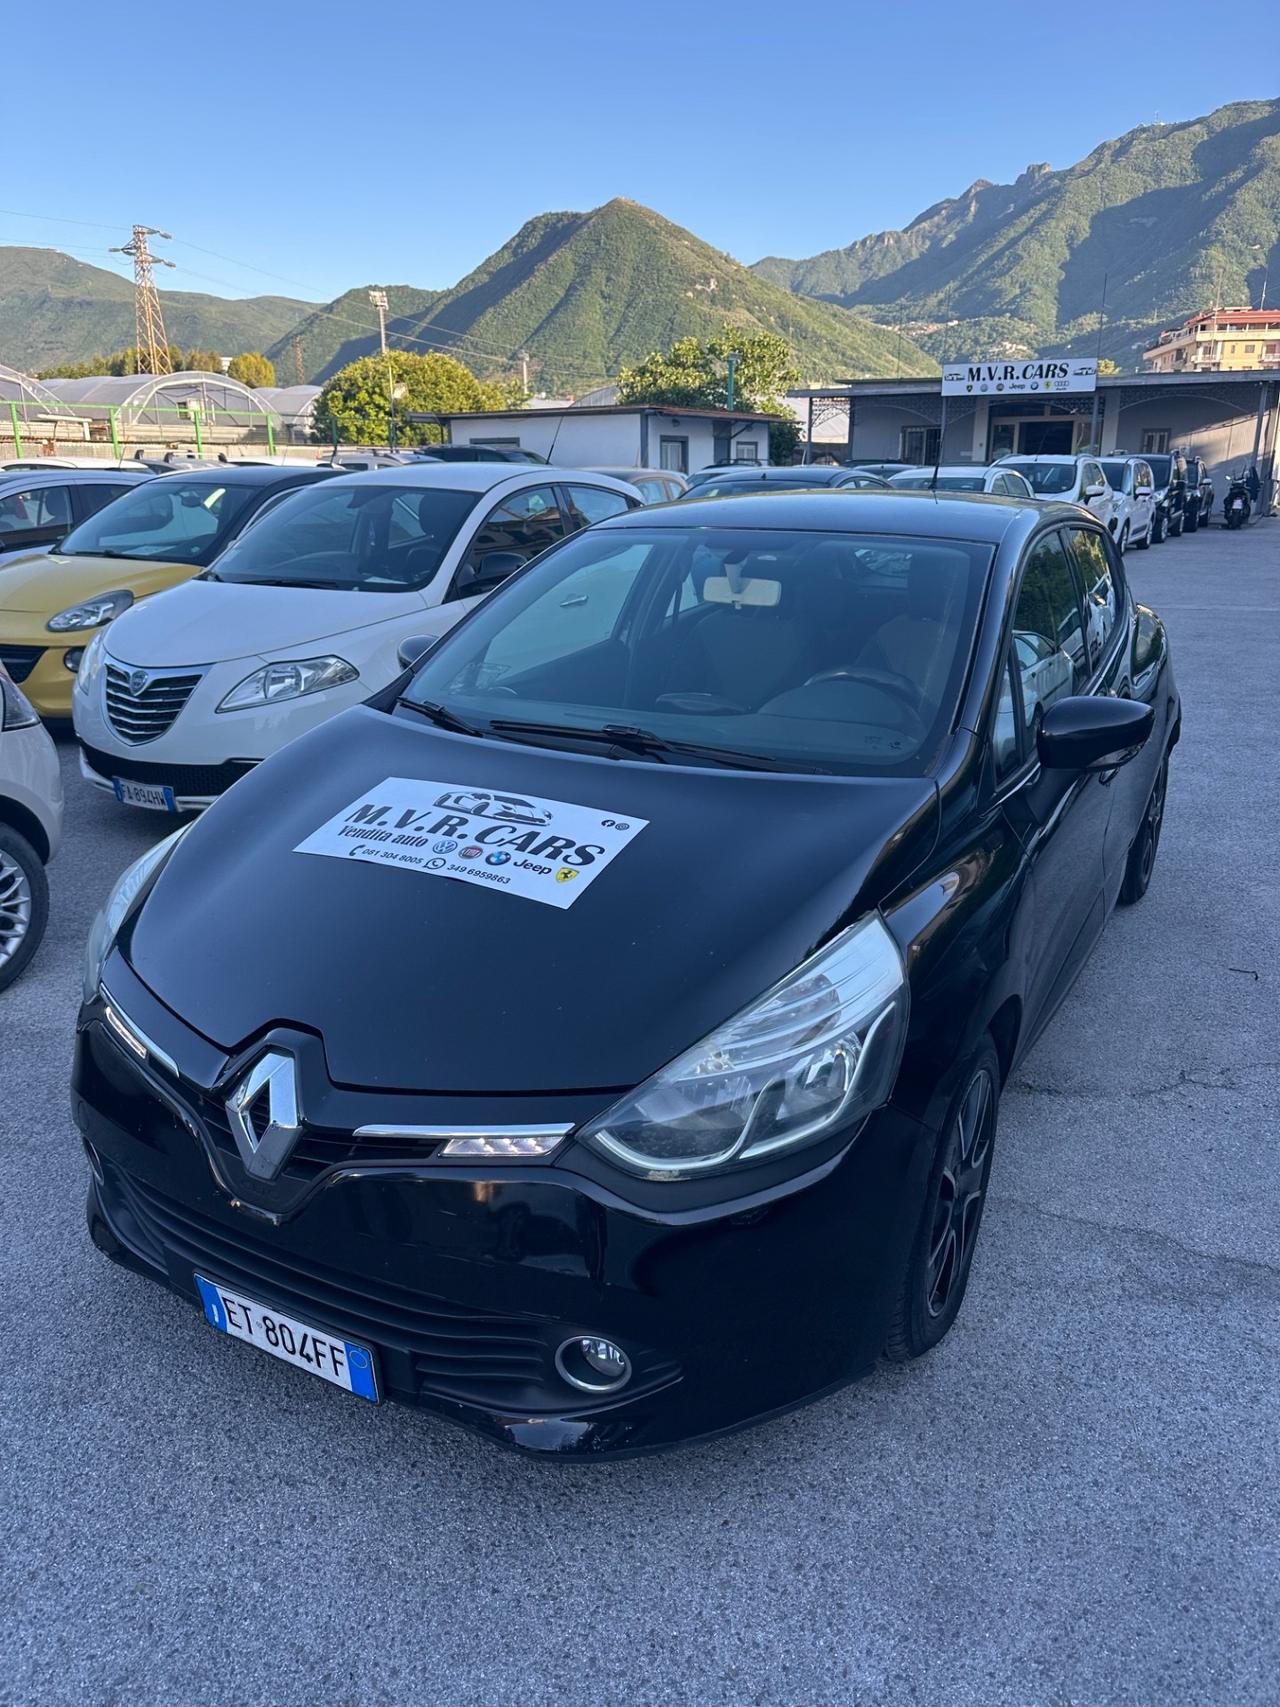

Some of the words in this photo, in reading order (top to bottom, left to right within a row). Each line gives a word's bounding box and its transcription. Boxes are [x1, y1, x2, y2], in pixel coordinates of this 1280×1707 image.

[337, 825, 393, 842] Vendita
[391, 834, 429, 848] auto
[447, 864, 467, 873] 349
[513, 859, 552, 875] Jeep
